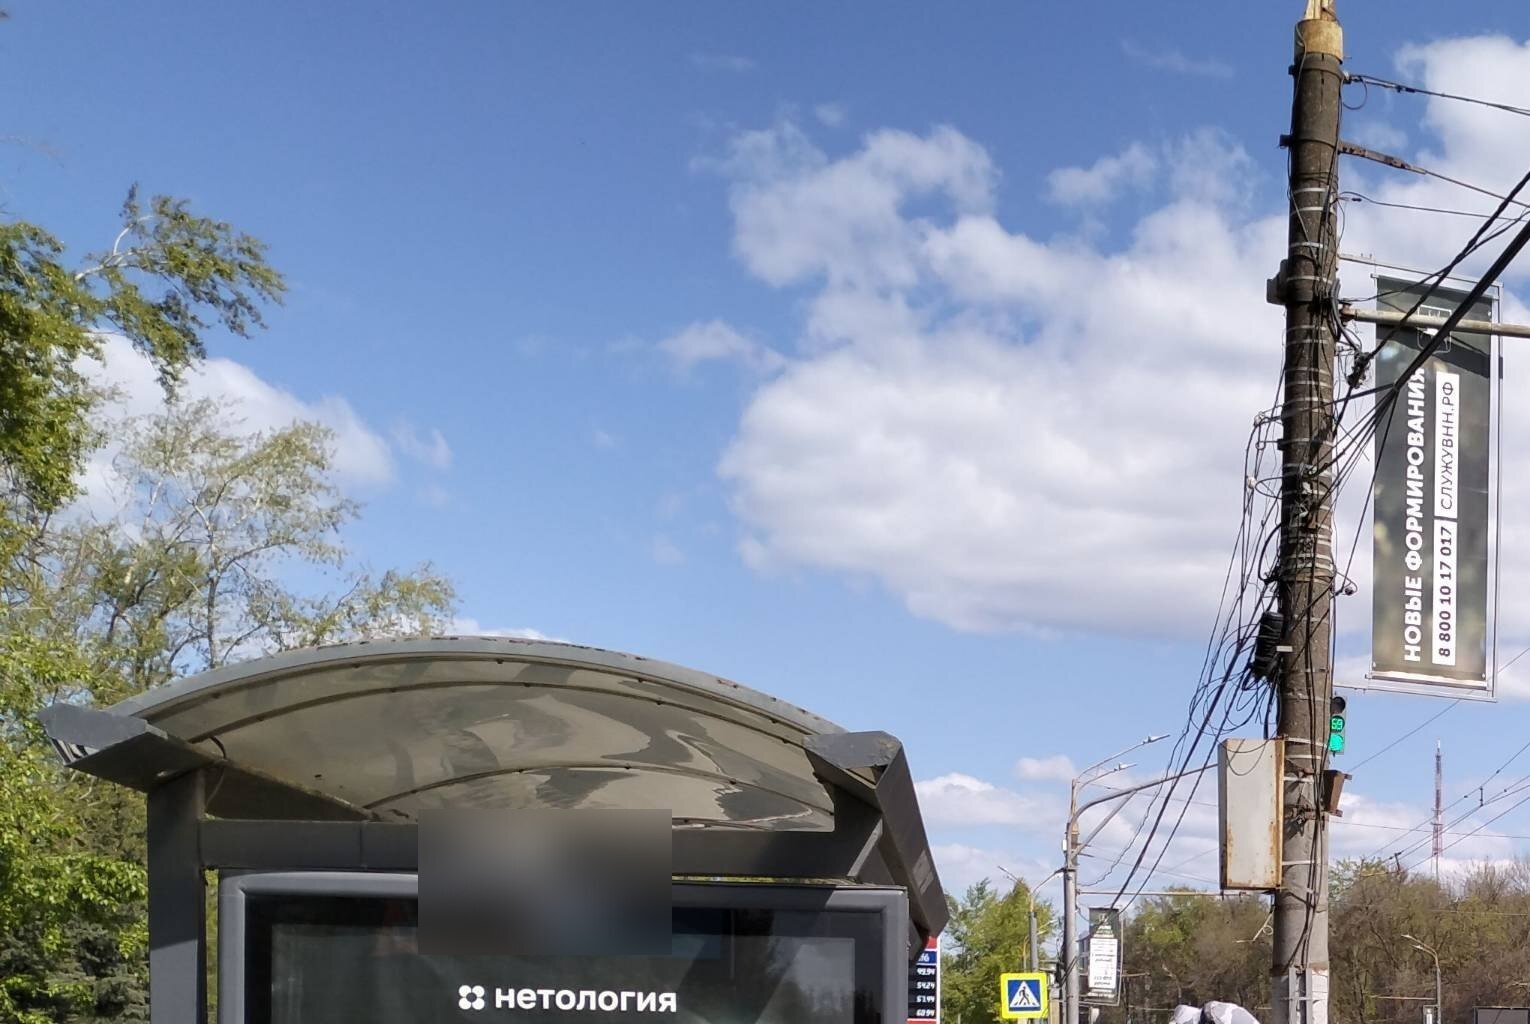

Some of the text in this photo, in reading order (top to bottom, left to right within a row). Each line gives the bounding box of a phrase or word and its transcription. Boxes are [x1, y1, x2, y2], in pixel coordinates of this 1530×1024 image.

[1440, 382, 1454, 510] СЛУЖУВНН.РФ
[1404, 367, 1425, 661] НОВЫЕ ФОРМИРОВАНИЯ
[1439, 526, 1452, 657] 8 800 10 17 017
[495, 987, 677, 1013] нетология
